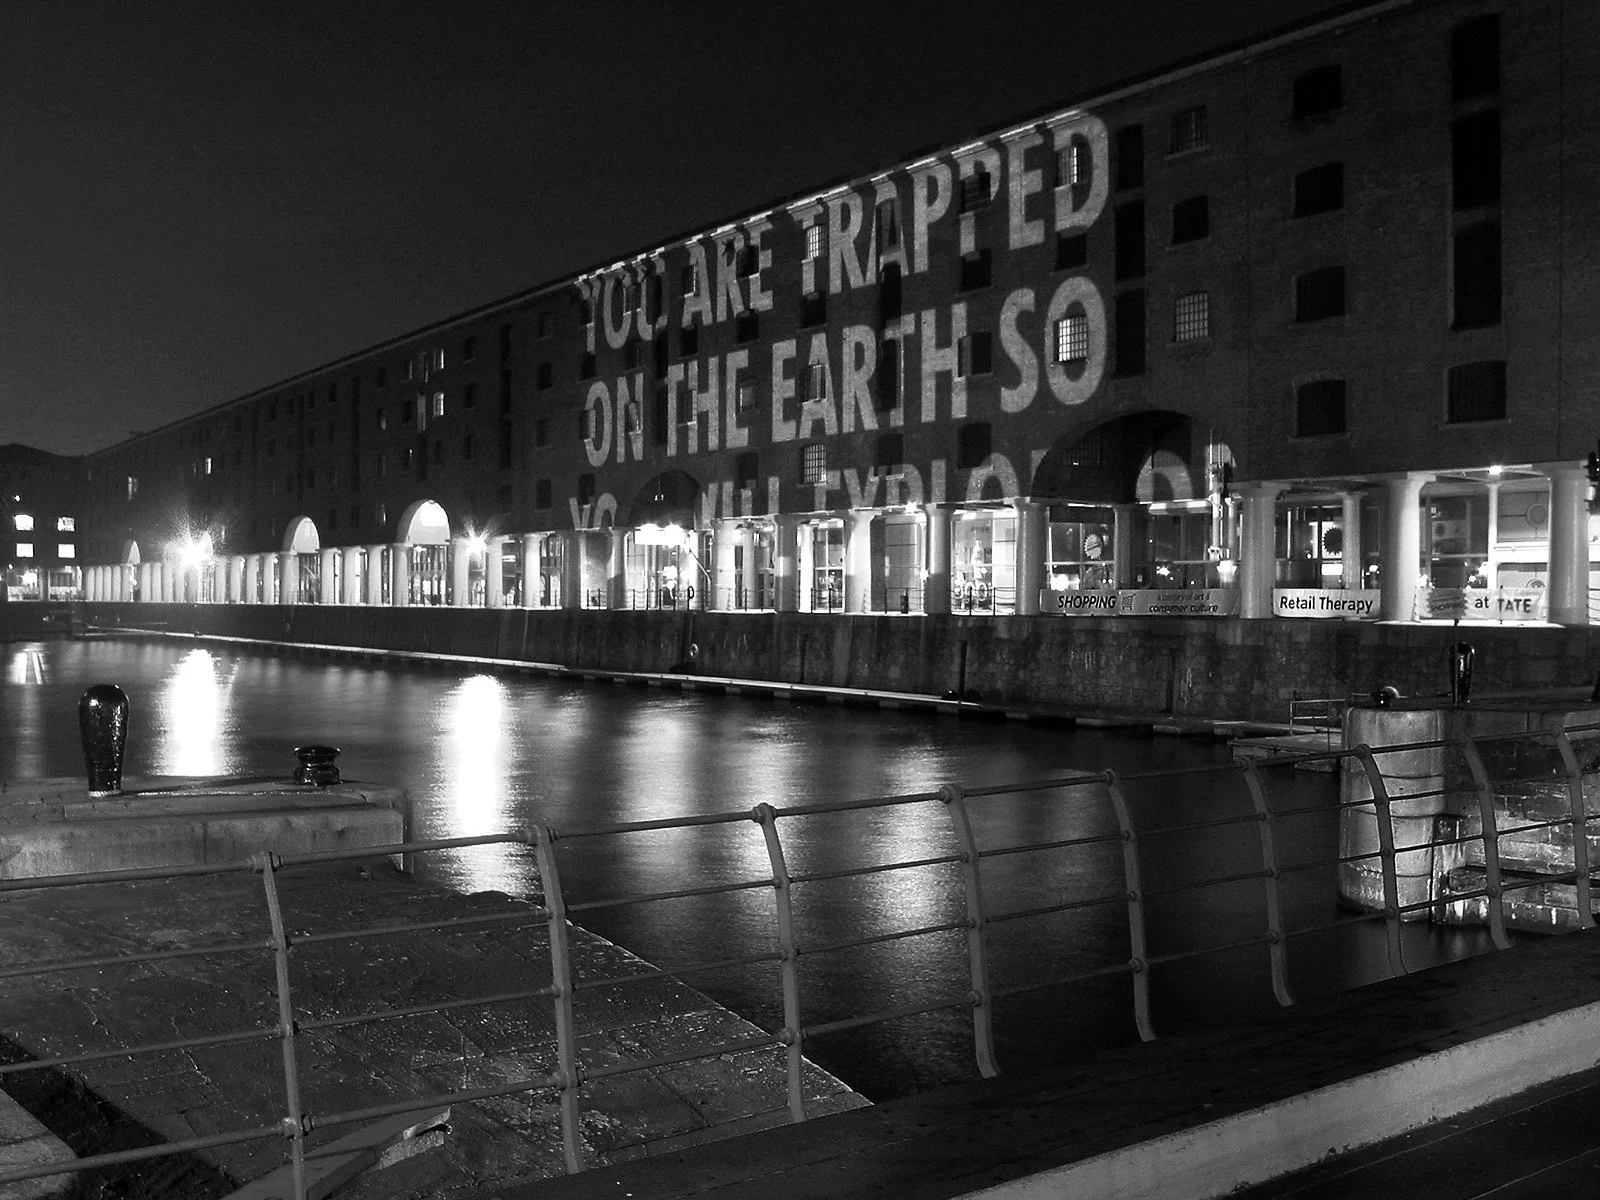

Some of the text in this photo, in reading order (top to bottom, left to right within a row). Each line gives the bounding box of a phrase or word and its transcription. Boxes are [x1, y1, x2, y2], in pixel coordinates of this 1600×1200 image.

[574, 114, 1109, 354] YOU ARE TRAPPED
[584, 276, 1107, 467] ON THE EARTH SO
[1057, 595, 1116, 609] SHOPPING
[1149, 603, 1218, 613] consumer culture
[1279, 595, 1374, 614] Retail Therapy
[1474, 597, 1489, 609] at
[1496, 598, 1532, 613] TATE
